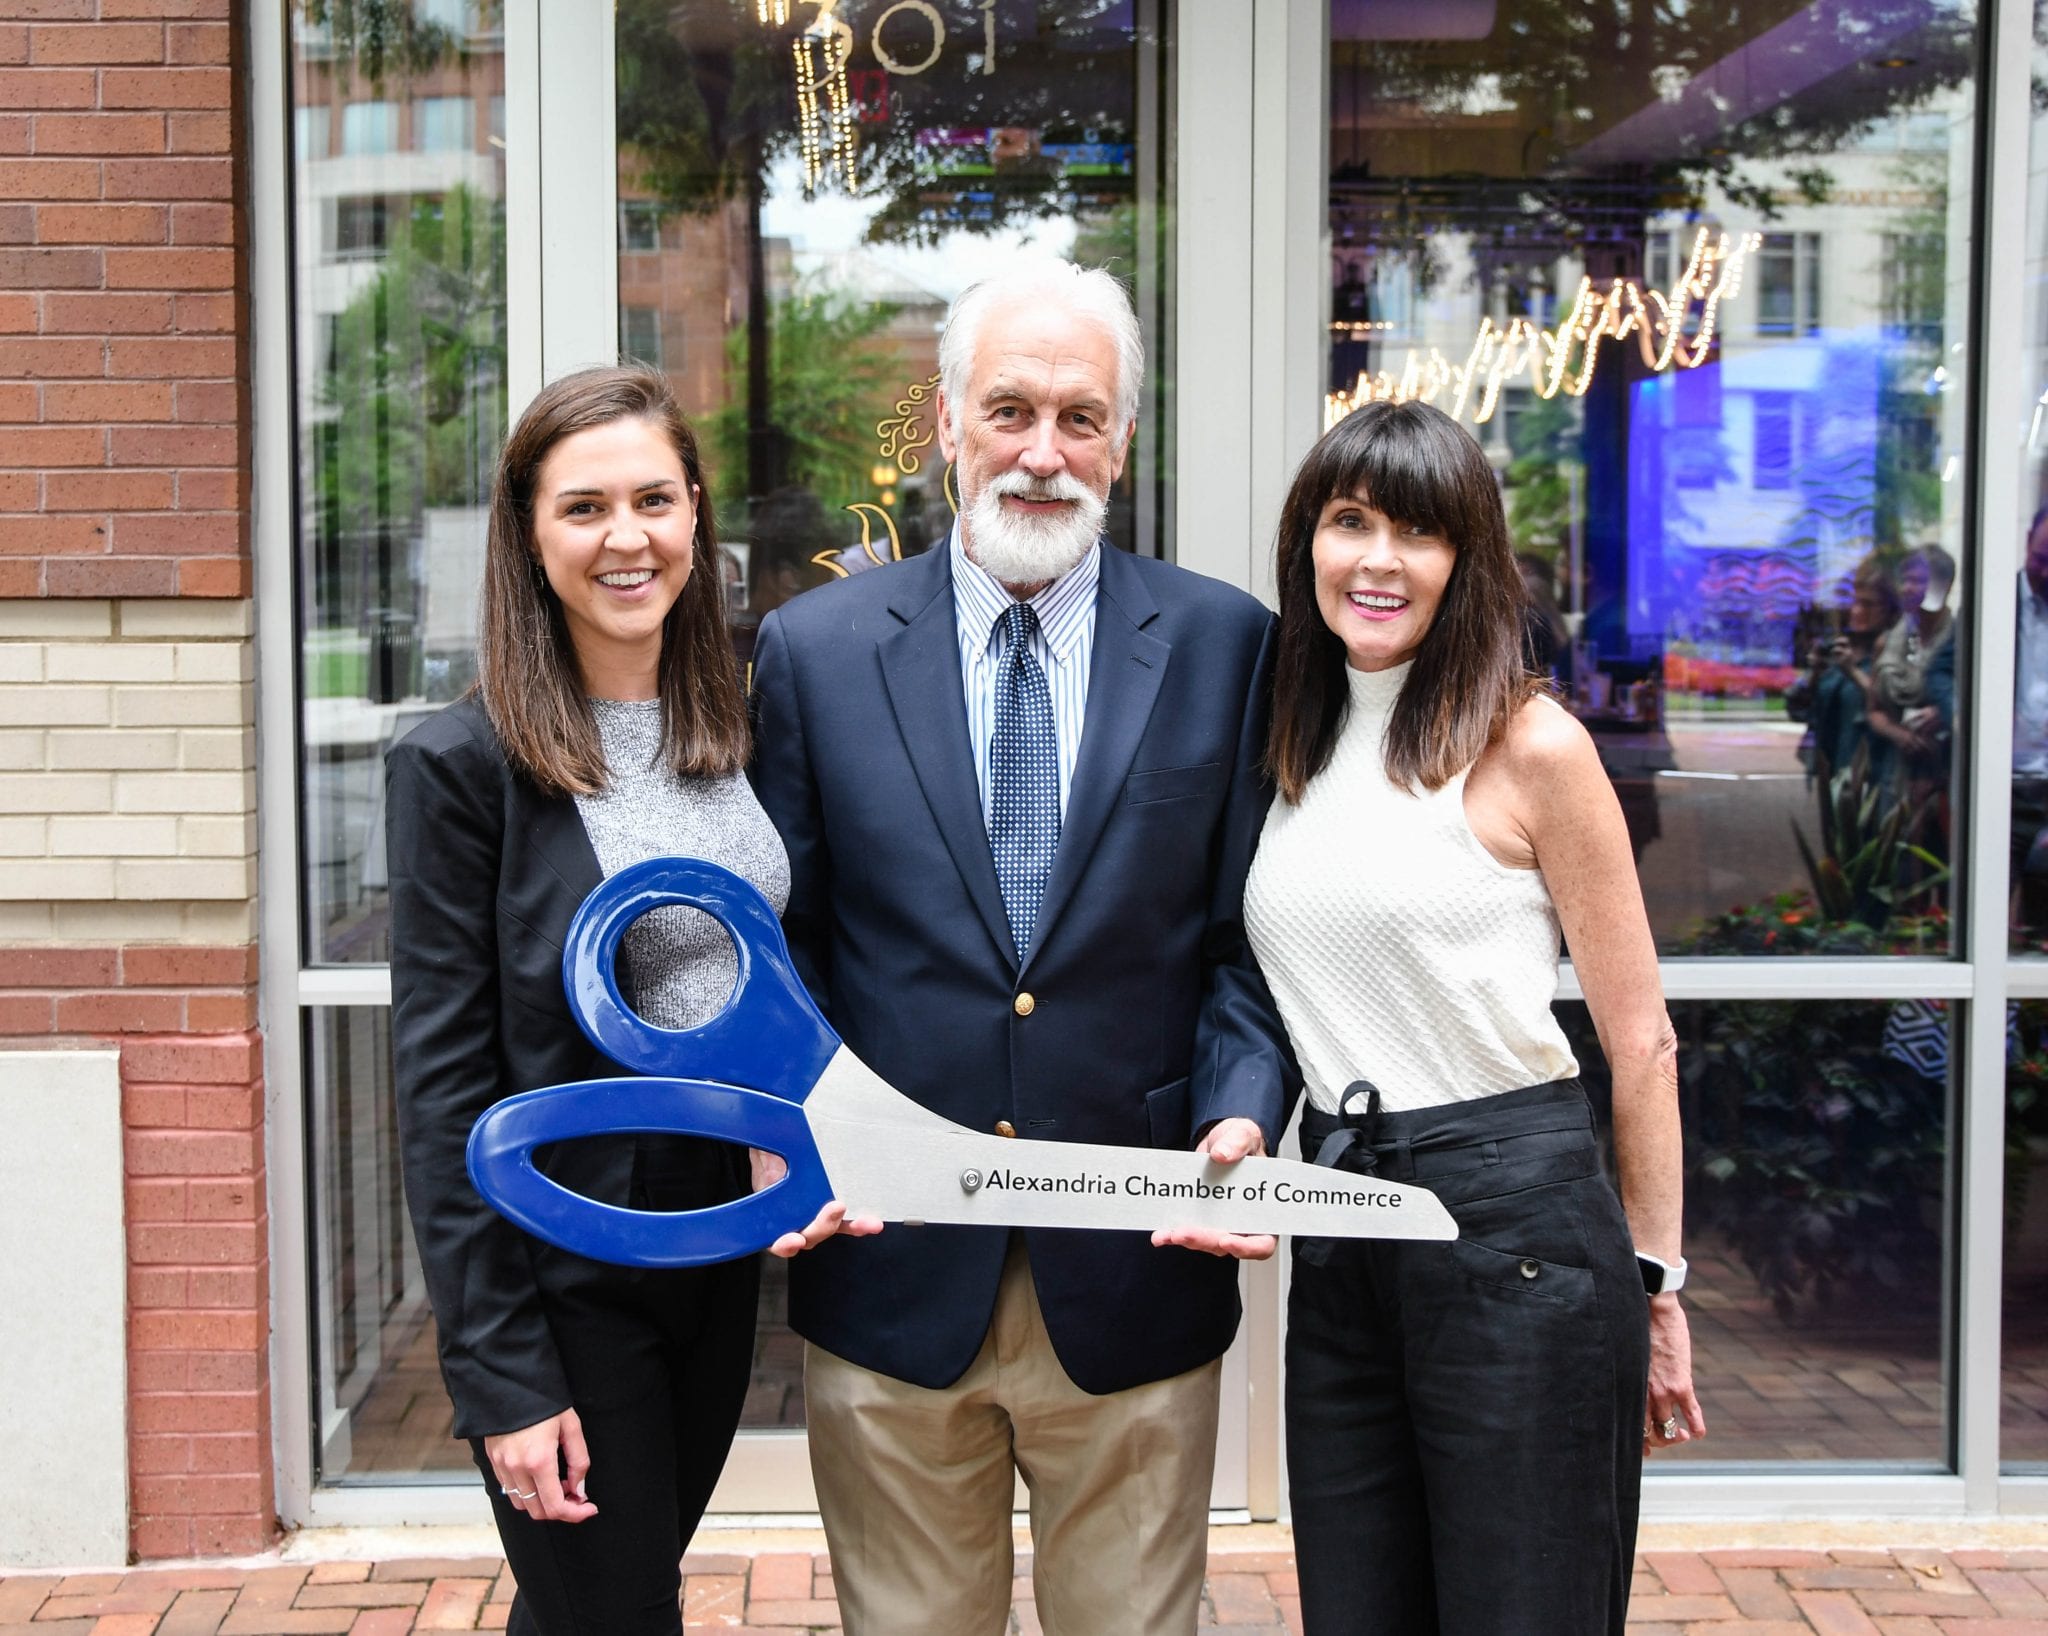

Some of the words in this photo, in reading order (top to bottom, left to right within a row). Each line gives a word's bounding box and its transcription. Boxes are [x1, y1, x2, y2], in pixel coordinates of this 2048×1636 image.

[985, 1168, 1117, 1195] Alexandria
[1124, 1174, 1236, 1201] Chamber
[1242, 1180, 1268, 1202] of
[1274, 1182, 1403, 1208] Commerce
